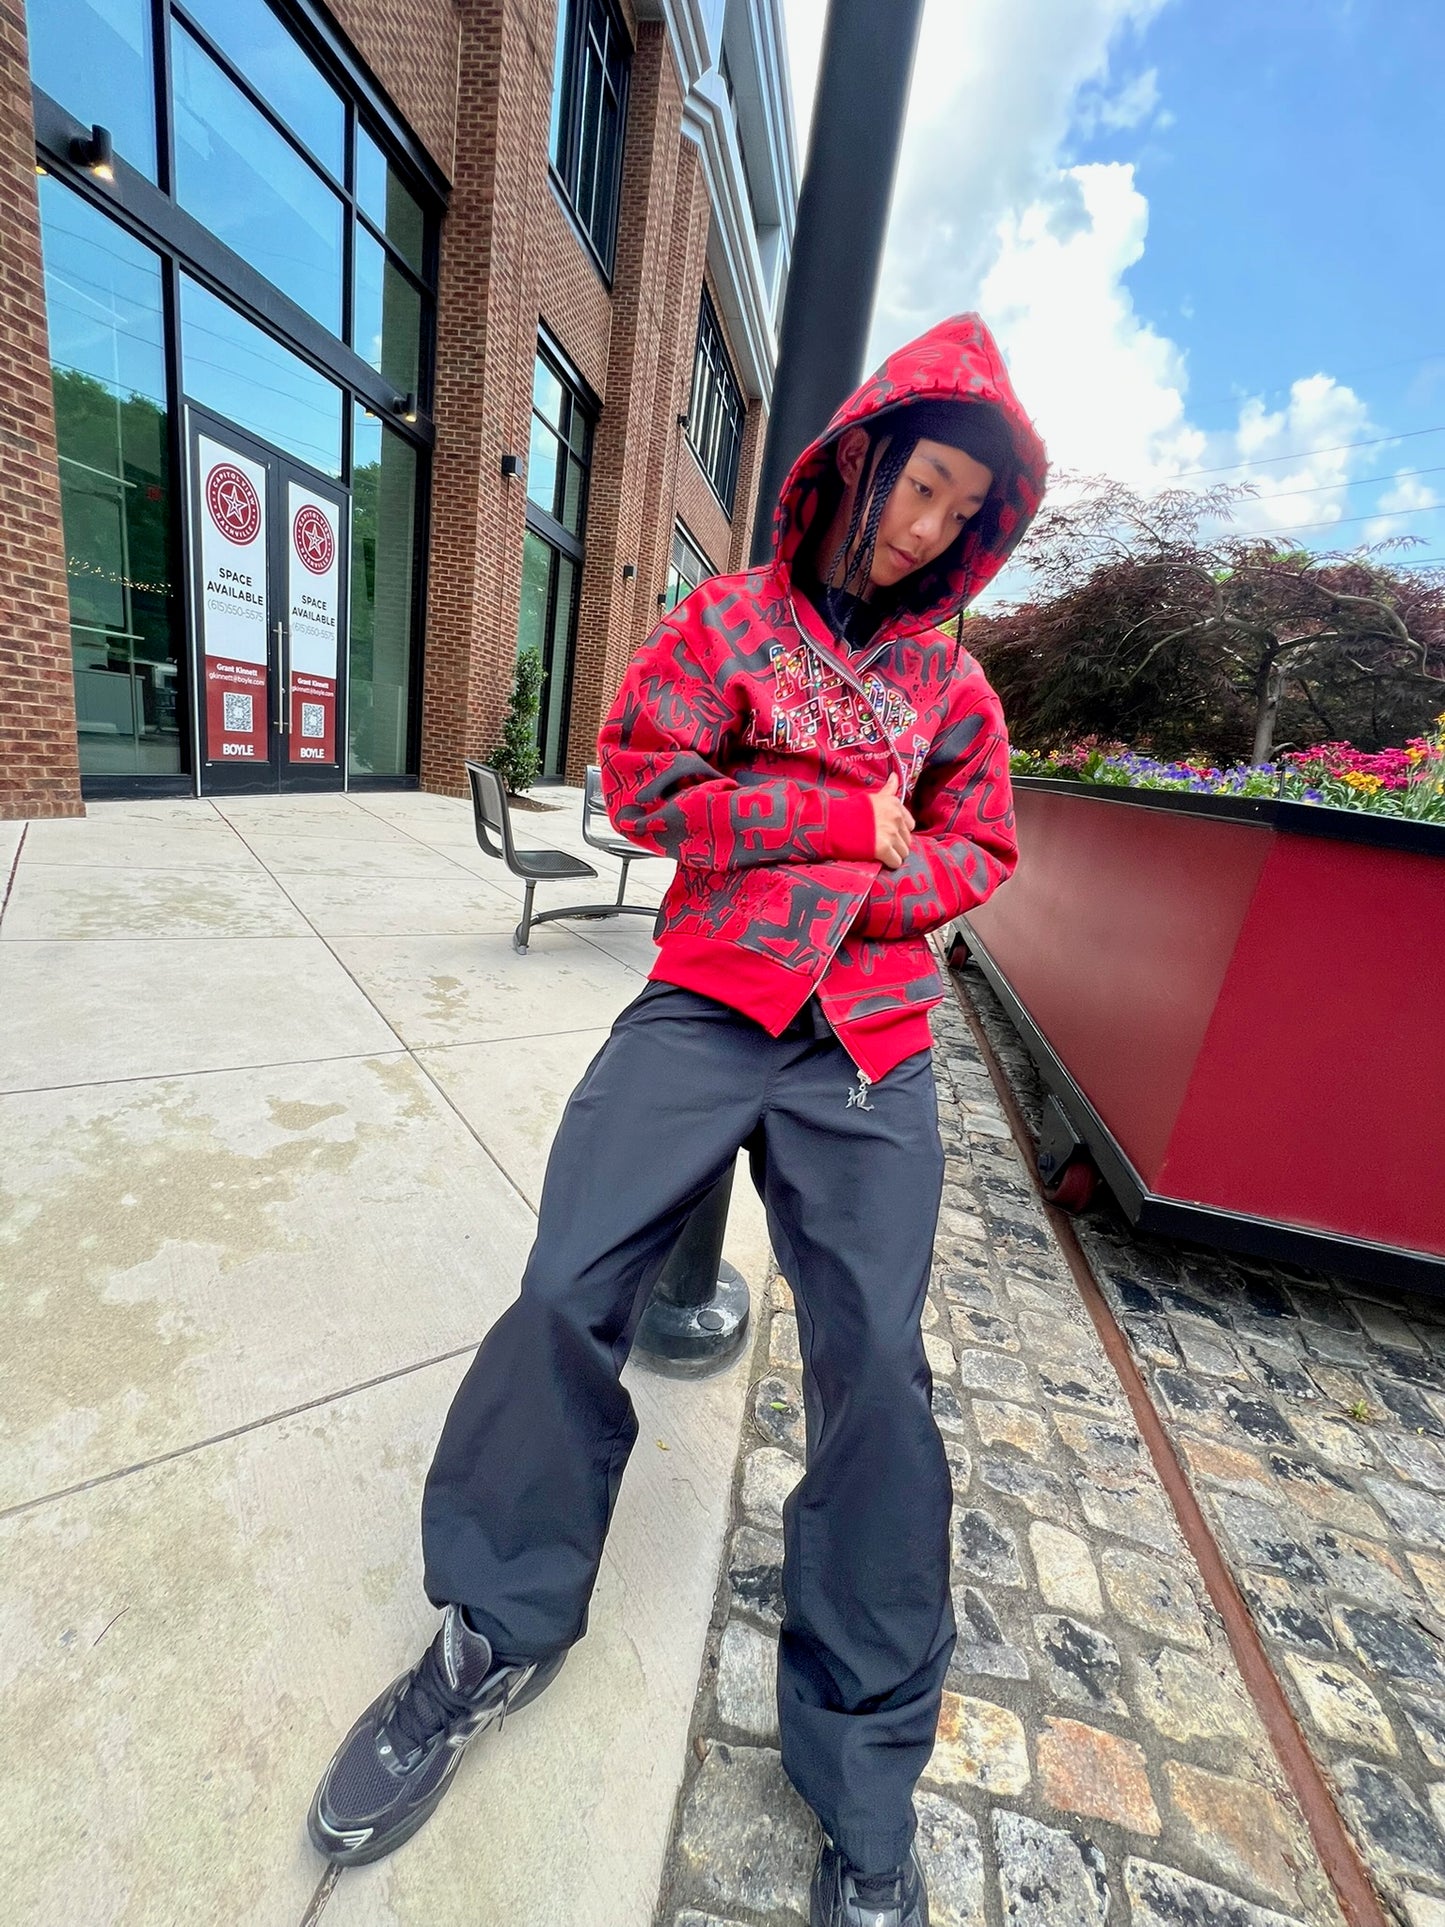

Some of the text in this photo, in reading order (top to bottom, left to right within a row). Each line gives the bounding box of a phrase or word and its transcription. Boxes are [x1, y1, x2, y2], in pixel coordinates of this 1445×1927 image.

[212, 471, 256, 505] CAPITOL VIEW
[216, 512, 254, 538] NASHVILLE
[298, 511, 331, 539] CAPITOL VIEW
[300, 547, 329, 569] NASHVILLE
[219, 567, 252, 587] SPACE
[207, 581, 264, 606] AVAILABLE
[301, 594, 327, 611] SPACE
[292, 606, 336, 627] AVAILABLE
[216, 663, 258, 677] Grant Kinnett
[222, 743, 255, 757] BOYLE
[300, 747, 325, 759] BOYLE
